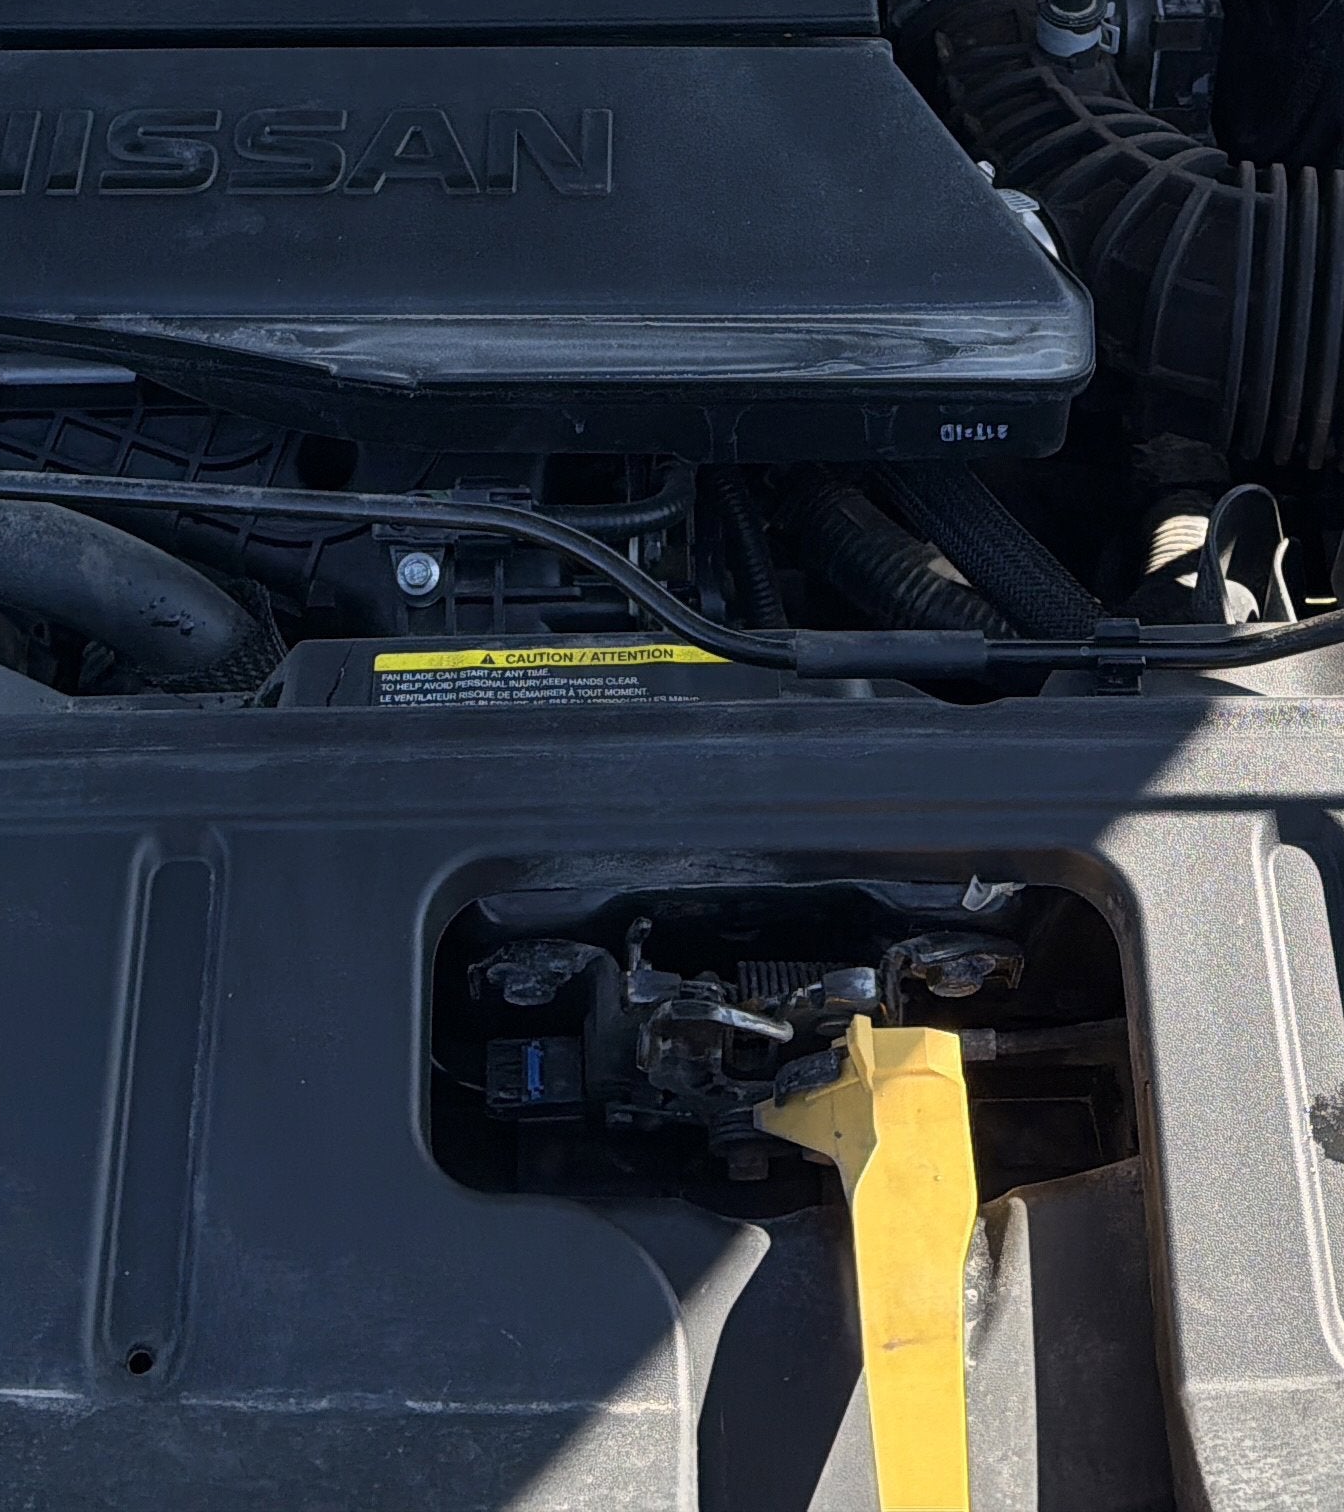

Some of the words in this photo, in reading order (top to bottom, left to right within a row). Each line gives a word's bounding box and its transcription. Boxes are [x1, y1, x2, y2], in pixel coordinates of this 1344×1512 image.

[506, 651, 574, 665] CAUTION
[590, 648, 674, 663] ATTENTION
[381, 673, 401, 682] FAN
[403, 672, 434, 681] BLADE
[436, 671, 457, 680] CAN
[459, 669, 489, 679] START
[492, 669, 503, 678] AT
[505, 669, 524, 678] ANY
[527, 667, 550, 677] TIME.
[381, 683, 395, 692] TO
[397, 682, 423, 691] HELP
[423, 681, 454, 690] AVOID
[455, 679, 507, 689] PERSONAL
[569, 677, 604, 686] HANDS
[379, 694, 392, 703] LE
[394, 692, 457, 702] VENTILATEUR
[459, 690, 495, 700] RISQUE
[497, 690, 512, 699] DE
[513, 687, 566, 698] DÉMARRER
[568, 687, 576, 696] À
[577, 688, 603, 697] TOUT
